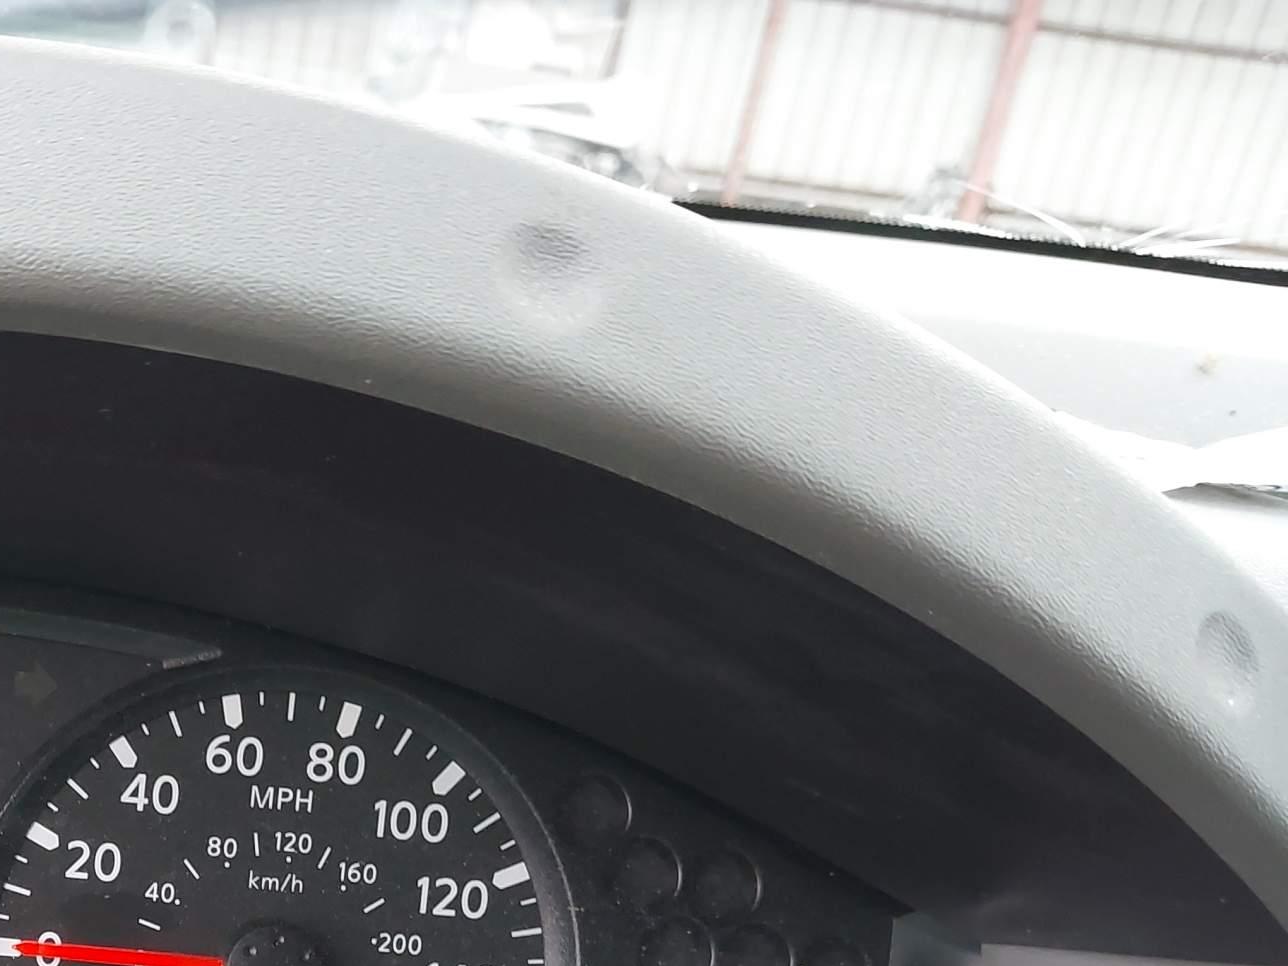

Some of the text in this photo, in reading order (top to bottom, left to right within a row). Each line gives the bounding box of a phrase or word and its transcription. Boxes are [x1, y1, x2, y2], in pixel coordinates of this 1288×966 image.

[205, 734, 264, 777] 60
[306, 742, 366, 785] 80
[120, 773, 180, 815] 40
[250, 785, 314, 813] MPH
[374, 799, 449, 843] 100
[207, 836, 238, 859] 80
[275, 831, 312, 854] 120
[65, 839, 121, 882] 20
[339, 862, 377, 885] 160
[144, 881, 174, 903] 40
[248, 869, 303, 893] km/h
[417, 876, 489, 919] 120
[378, 932, 422, 956] 200
